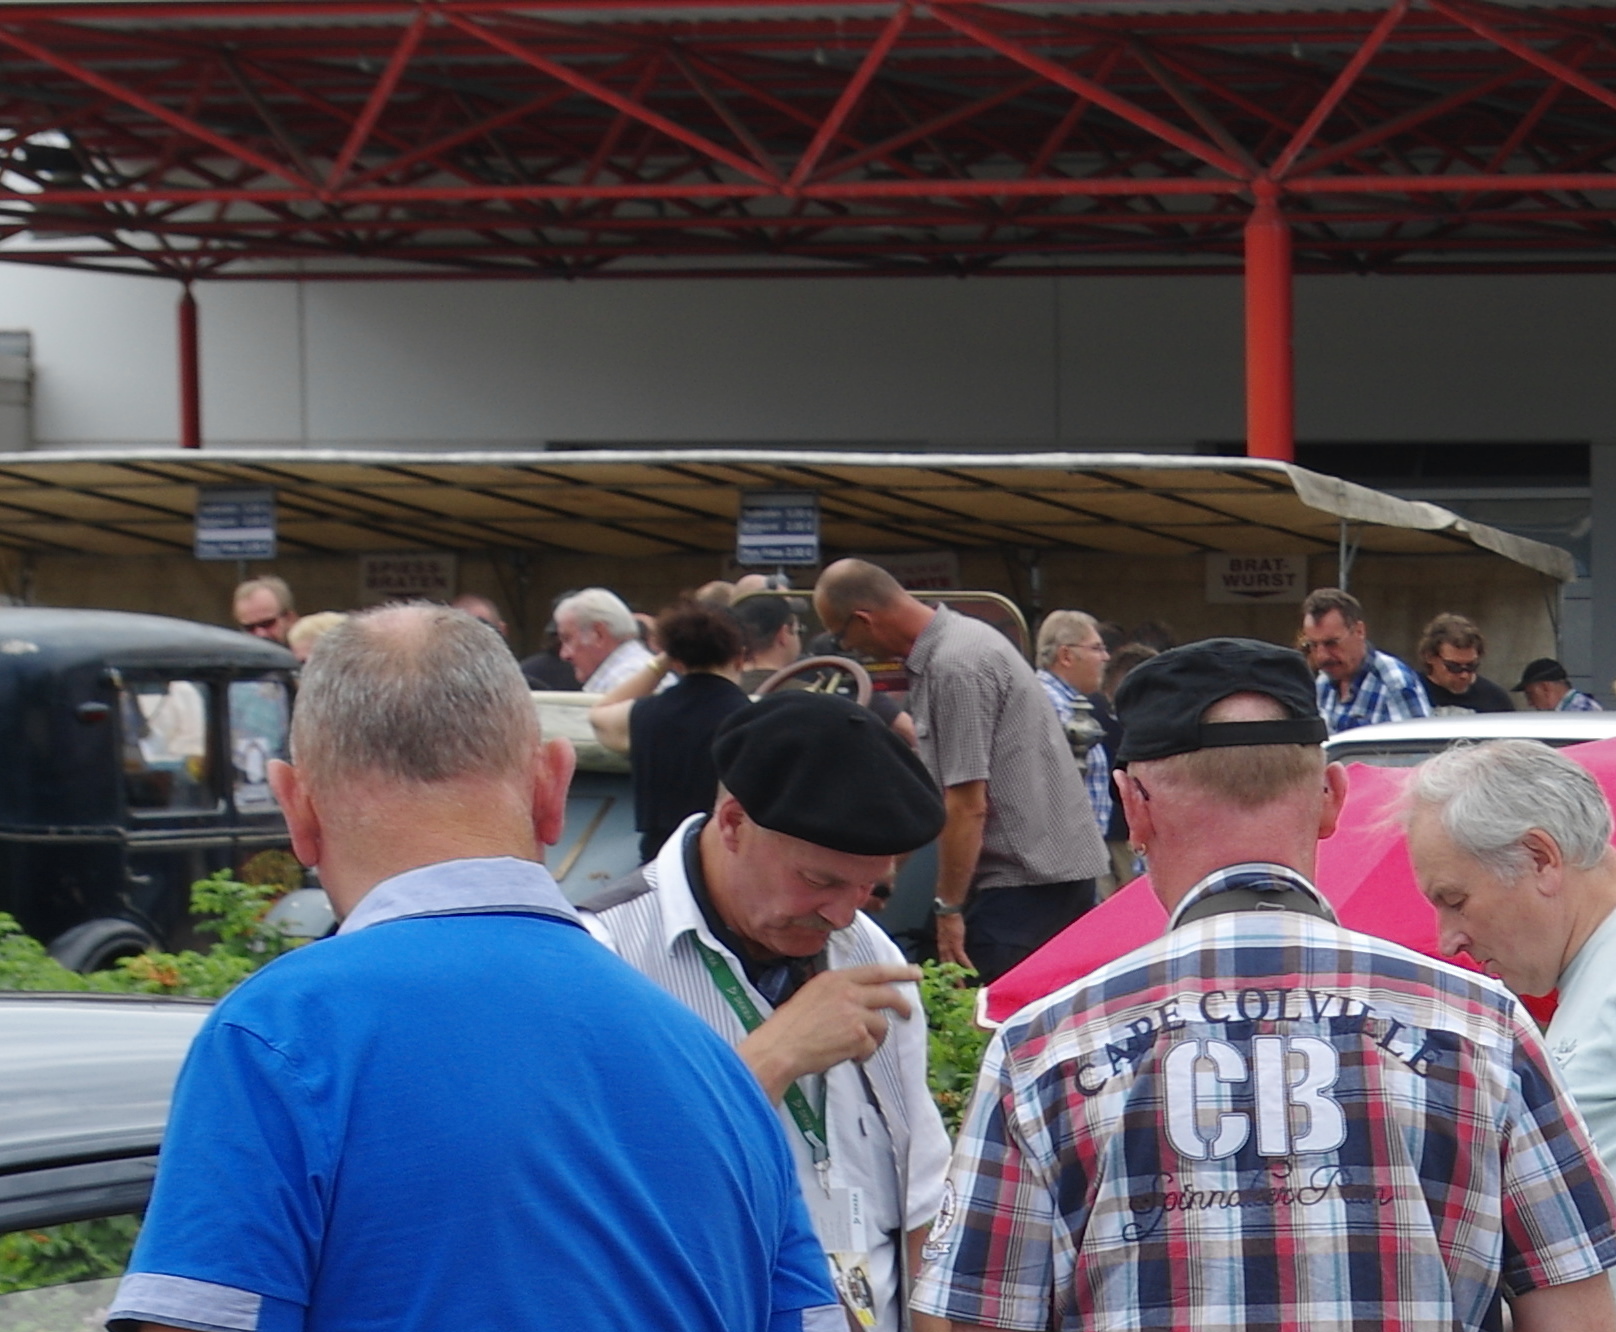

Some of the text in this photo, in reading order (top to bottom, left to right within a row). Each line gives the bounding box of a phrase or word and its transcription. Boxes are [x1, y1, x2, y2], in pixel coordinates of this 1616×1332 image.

[1223, 573, 1297, 587] WURST
[1230, 558, 1290, 571] BRAT-
[1074, 987, 1444, 1096] CAPE COLVILLE
[1161, 1034, 1349, 1161] CB
